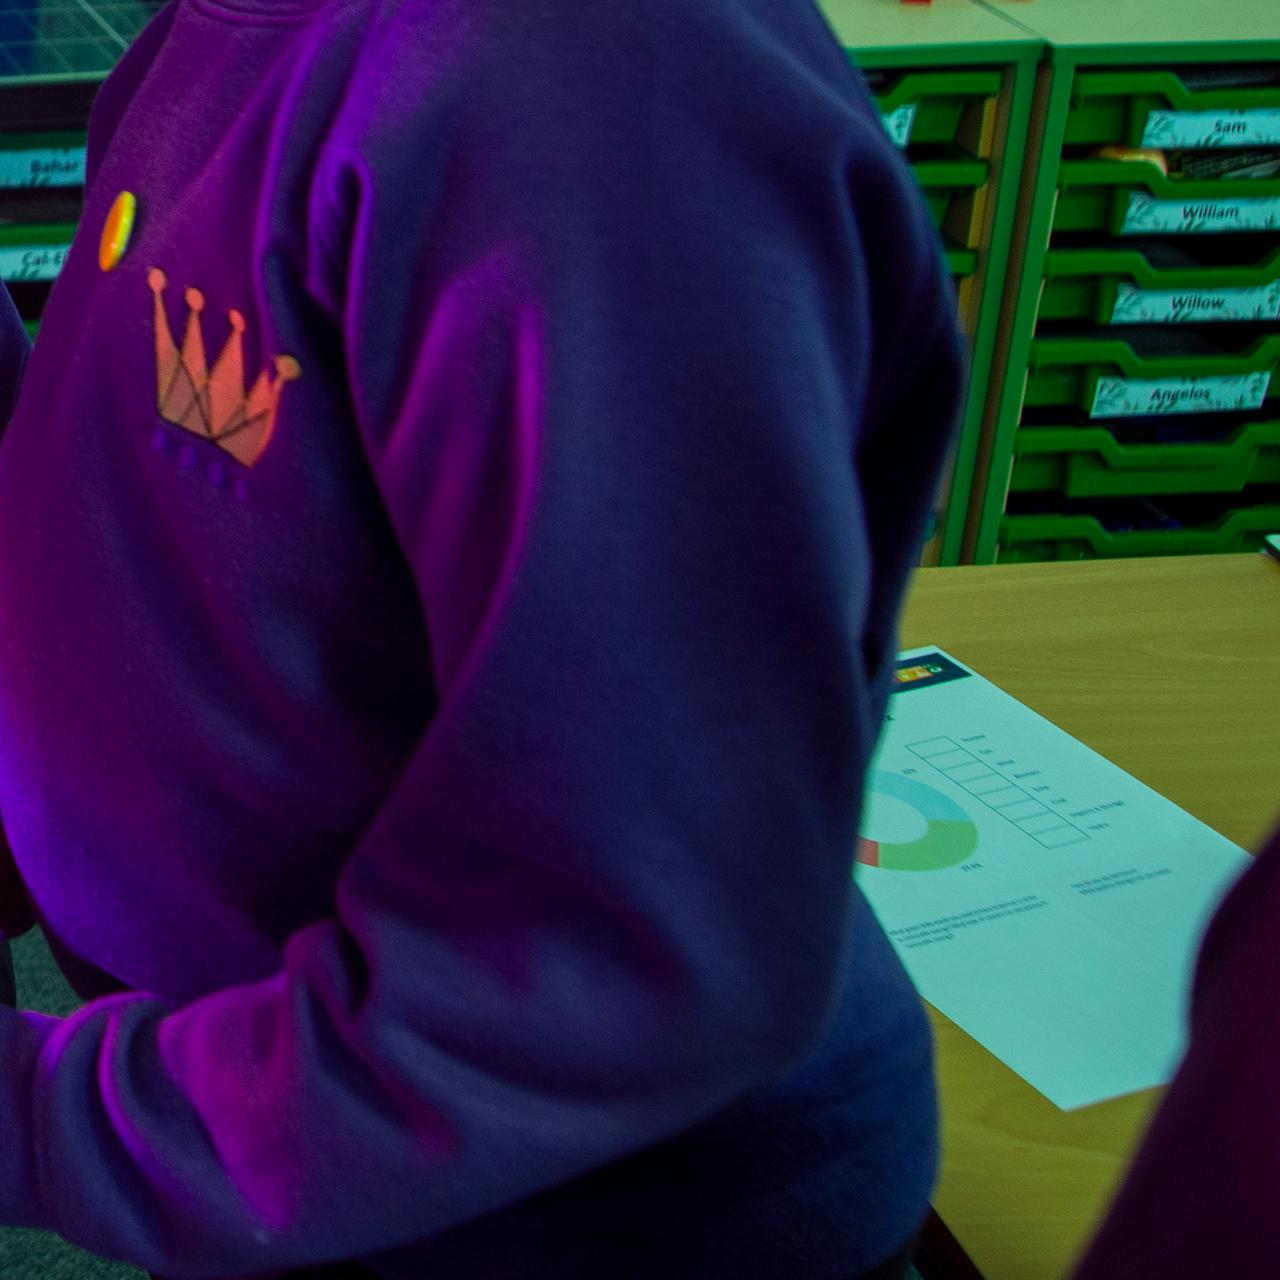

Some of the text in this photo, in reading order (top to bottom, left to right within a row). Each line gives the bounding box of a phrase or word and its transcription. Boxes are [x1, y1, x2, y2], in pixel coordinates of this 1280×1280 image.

[1213, 120, 1247, 133] Sam
[1182, 203, 1240, 219] William
[1171, 294, 1225, 311] Willow
